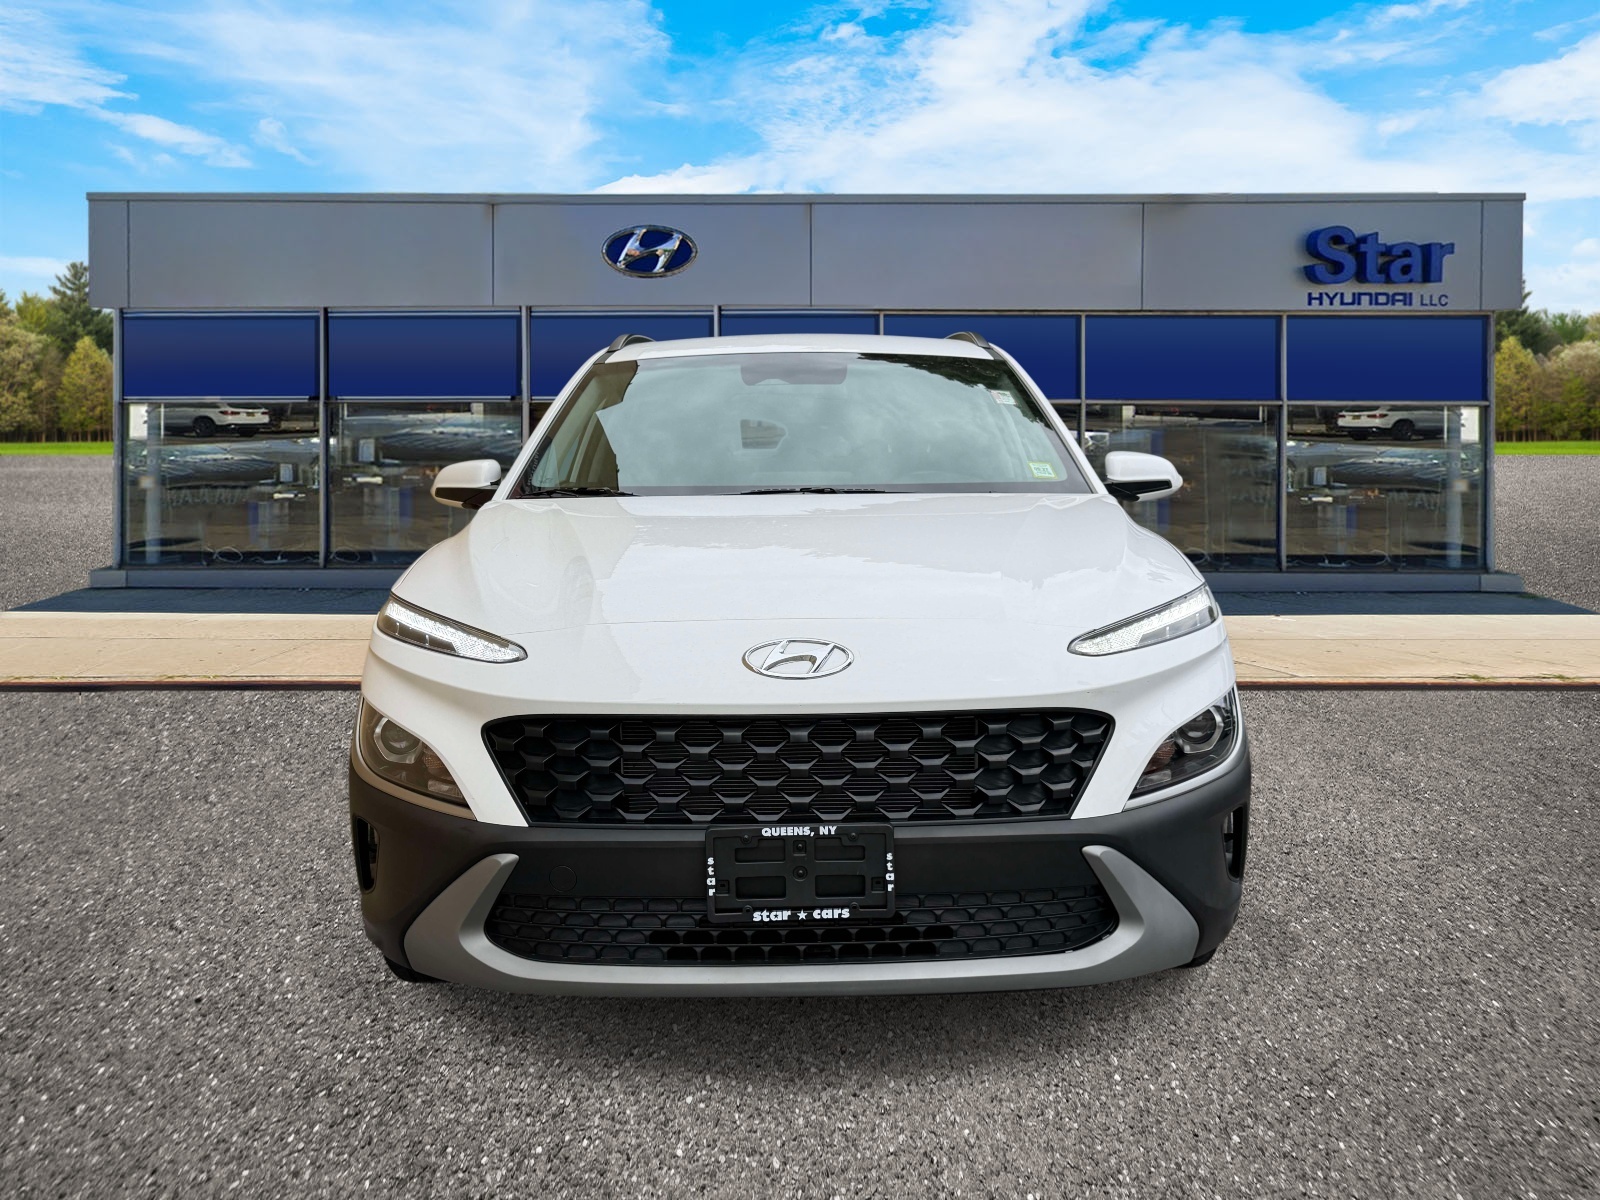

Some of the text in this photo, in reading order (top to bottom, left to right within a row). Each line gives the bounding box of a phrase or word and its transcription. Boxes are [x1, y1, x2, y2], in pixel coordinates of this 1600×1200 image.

[1304, 226, 1455, 284] Star
[1307, 292, 1449, 307] HYUNDAI LLC
[761, 826, 837, 837] QUEENS, NY
[707, 857, 716, 896] star
[886, 852, 894, 892] star
[752, 907, 850, 922] star cars
